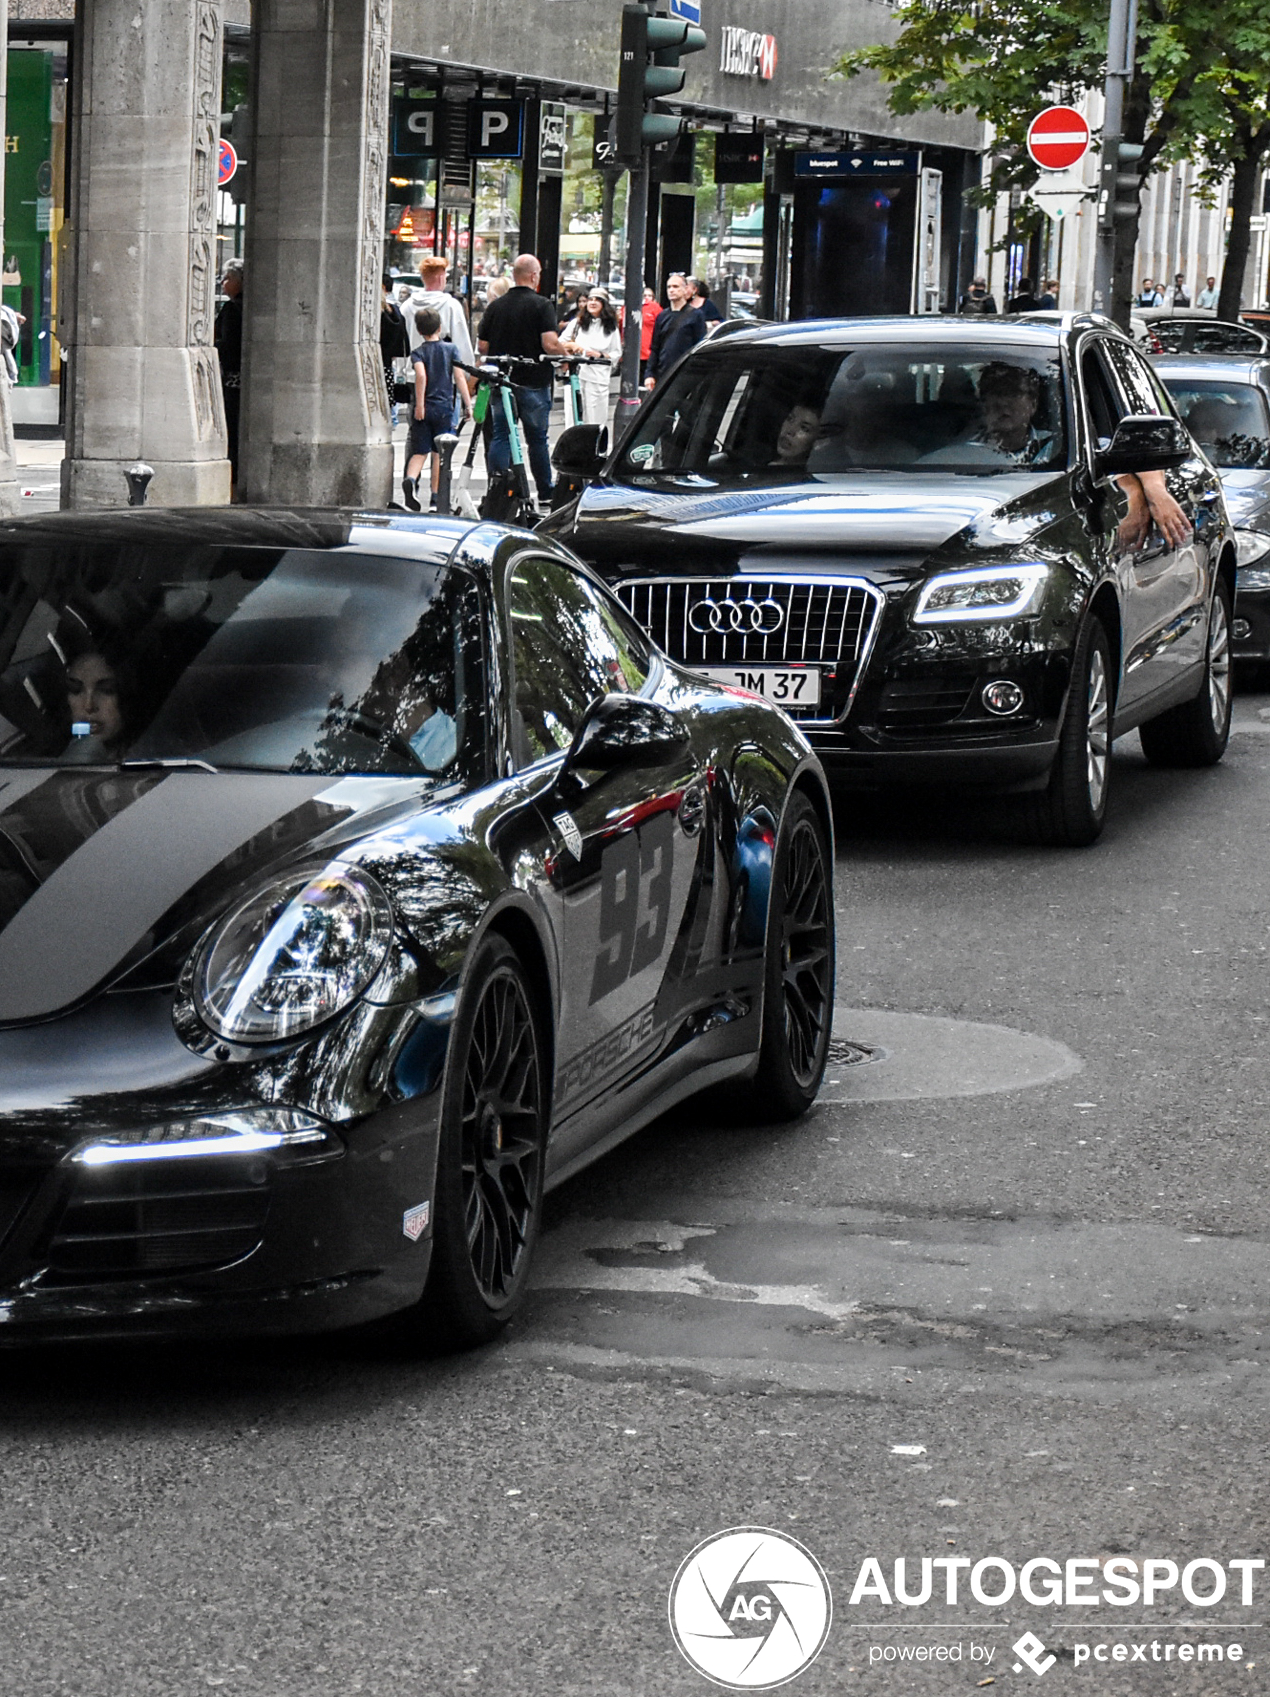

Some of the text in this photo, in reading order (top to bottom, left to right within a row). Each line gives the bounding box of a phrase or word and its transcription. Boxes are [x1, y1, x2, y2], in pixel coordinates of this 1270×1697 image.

[481, 111, 509, 147] P
[873, 159, 888, 167] Free
[773, 673, 807, 700] 37
[557, 816, 576, 832] TAG
[588, 810, 674, 1007] 93
